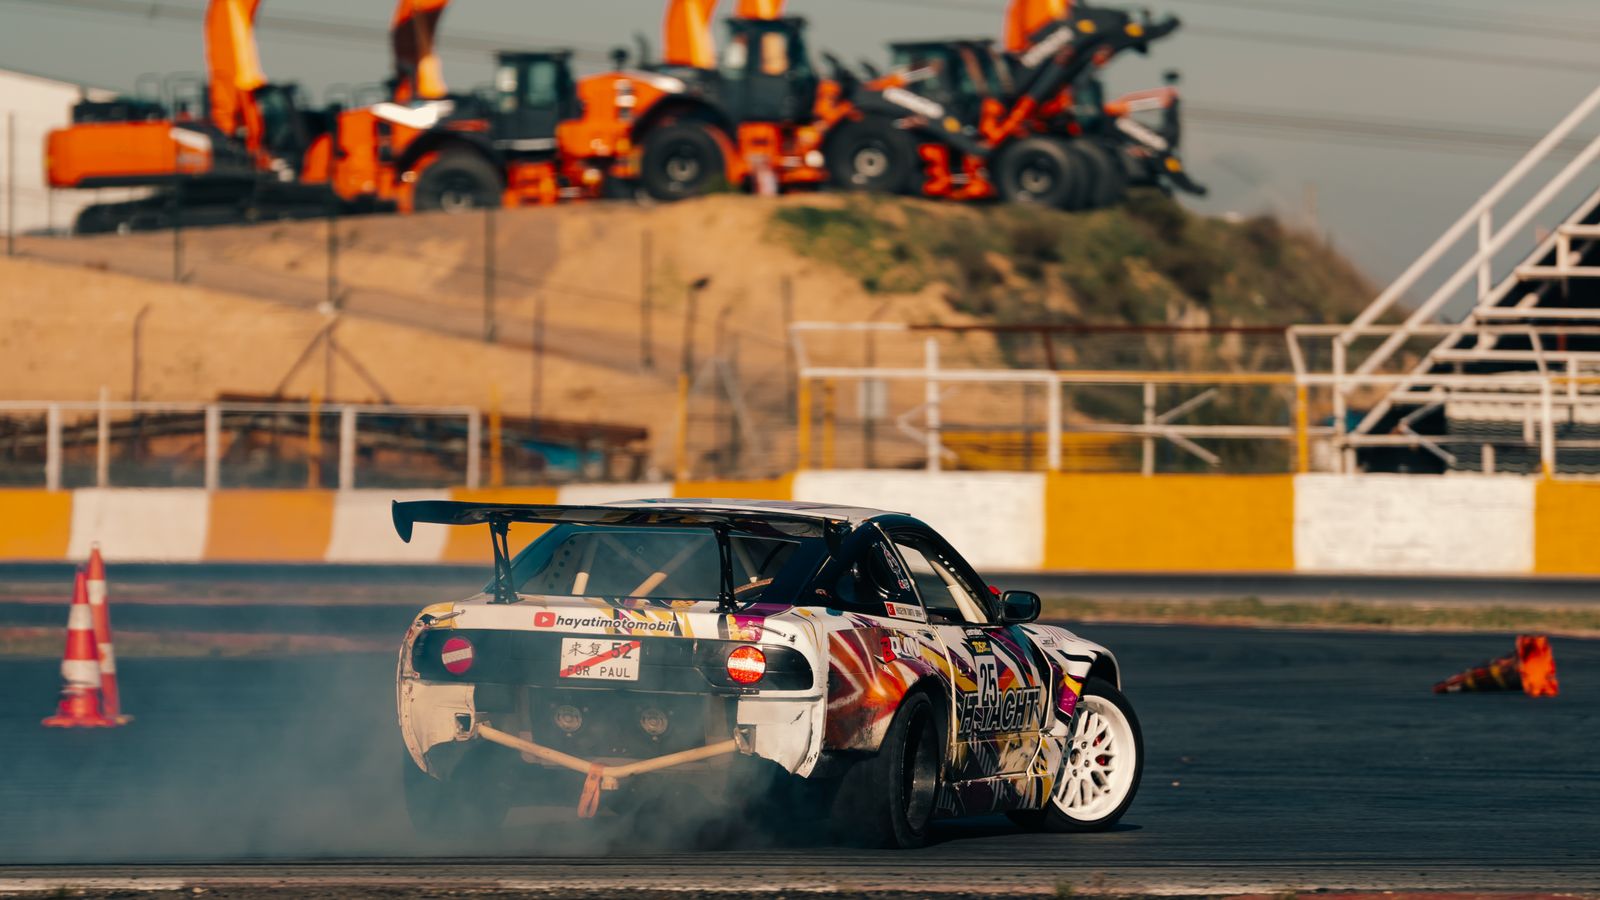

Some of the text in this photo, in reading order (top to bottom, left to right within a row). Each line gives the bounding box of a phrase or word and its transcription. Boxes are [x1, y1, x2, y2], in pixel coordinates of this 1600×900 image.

[556, 616, 675, 632] hayatimotomobil
[611, 642, 632, 659] 52
[567, 664, 631, 679] FOR PAUL
[980, 662, 997, 706] 25
